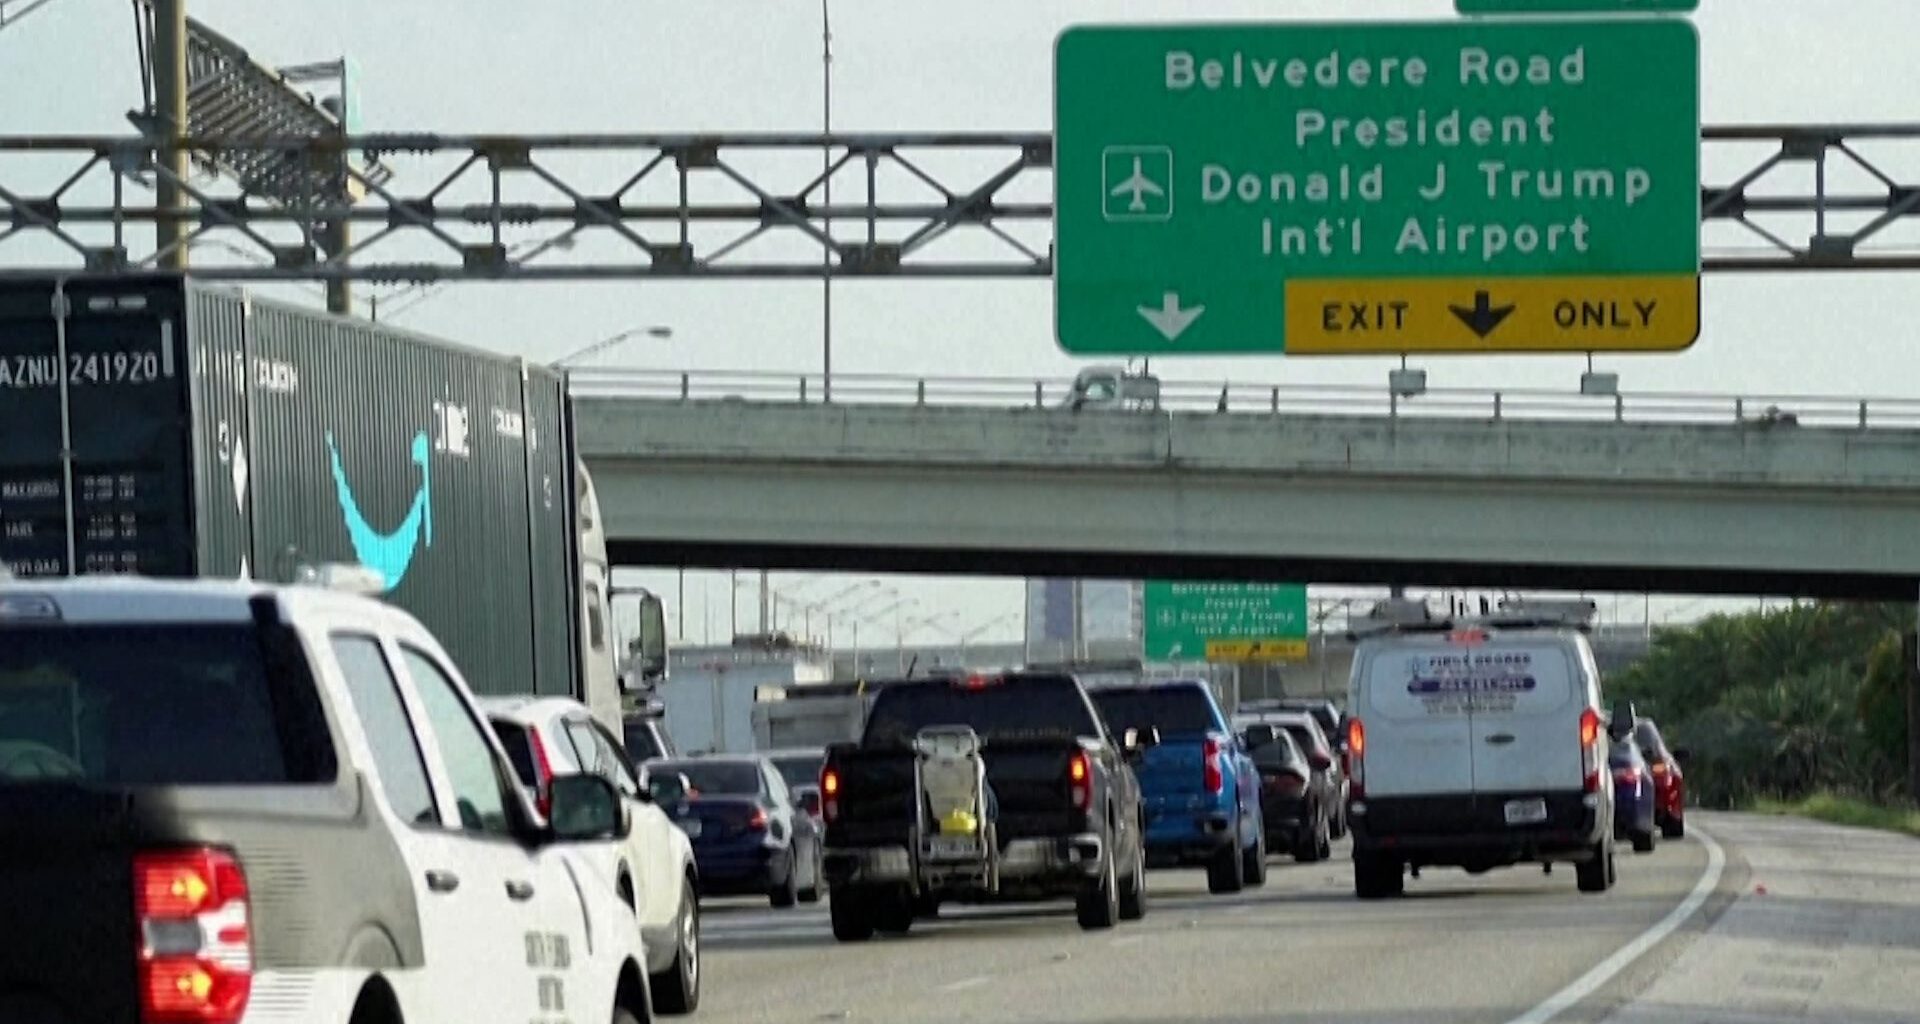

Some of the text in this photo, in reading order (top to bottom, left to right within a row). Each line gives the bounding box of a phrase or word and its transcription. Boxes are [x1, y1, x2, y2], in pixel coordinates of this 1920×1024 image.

[1165, 45, 1586, 89] Belvedere Road
[1295, 107, 1556, 148] President
[1201, 160, 1653, 207] Donald J Trump
[1261, 215, 1590, 261] Int'l Airport
[1322, 299, 1658, 331] EXIT ONLY
[0, 355, 58, 387] AZNU
[69, 350, 159, 386] 241920
